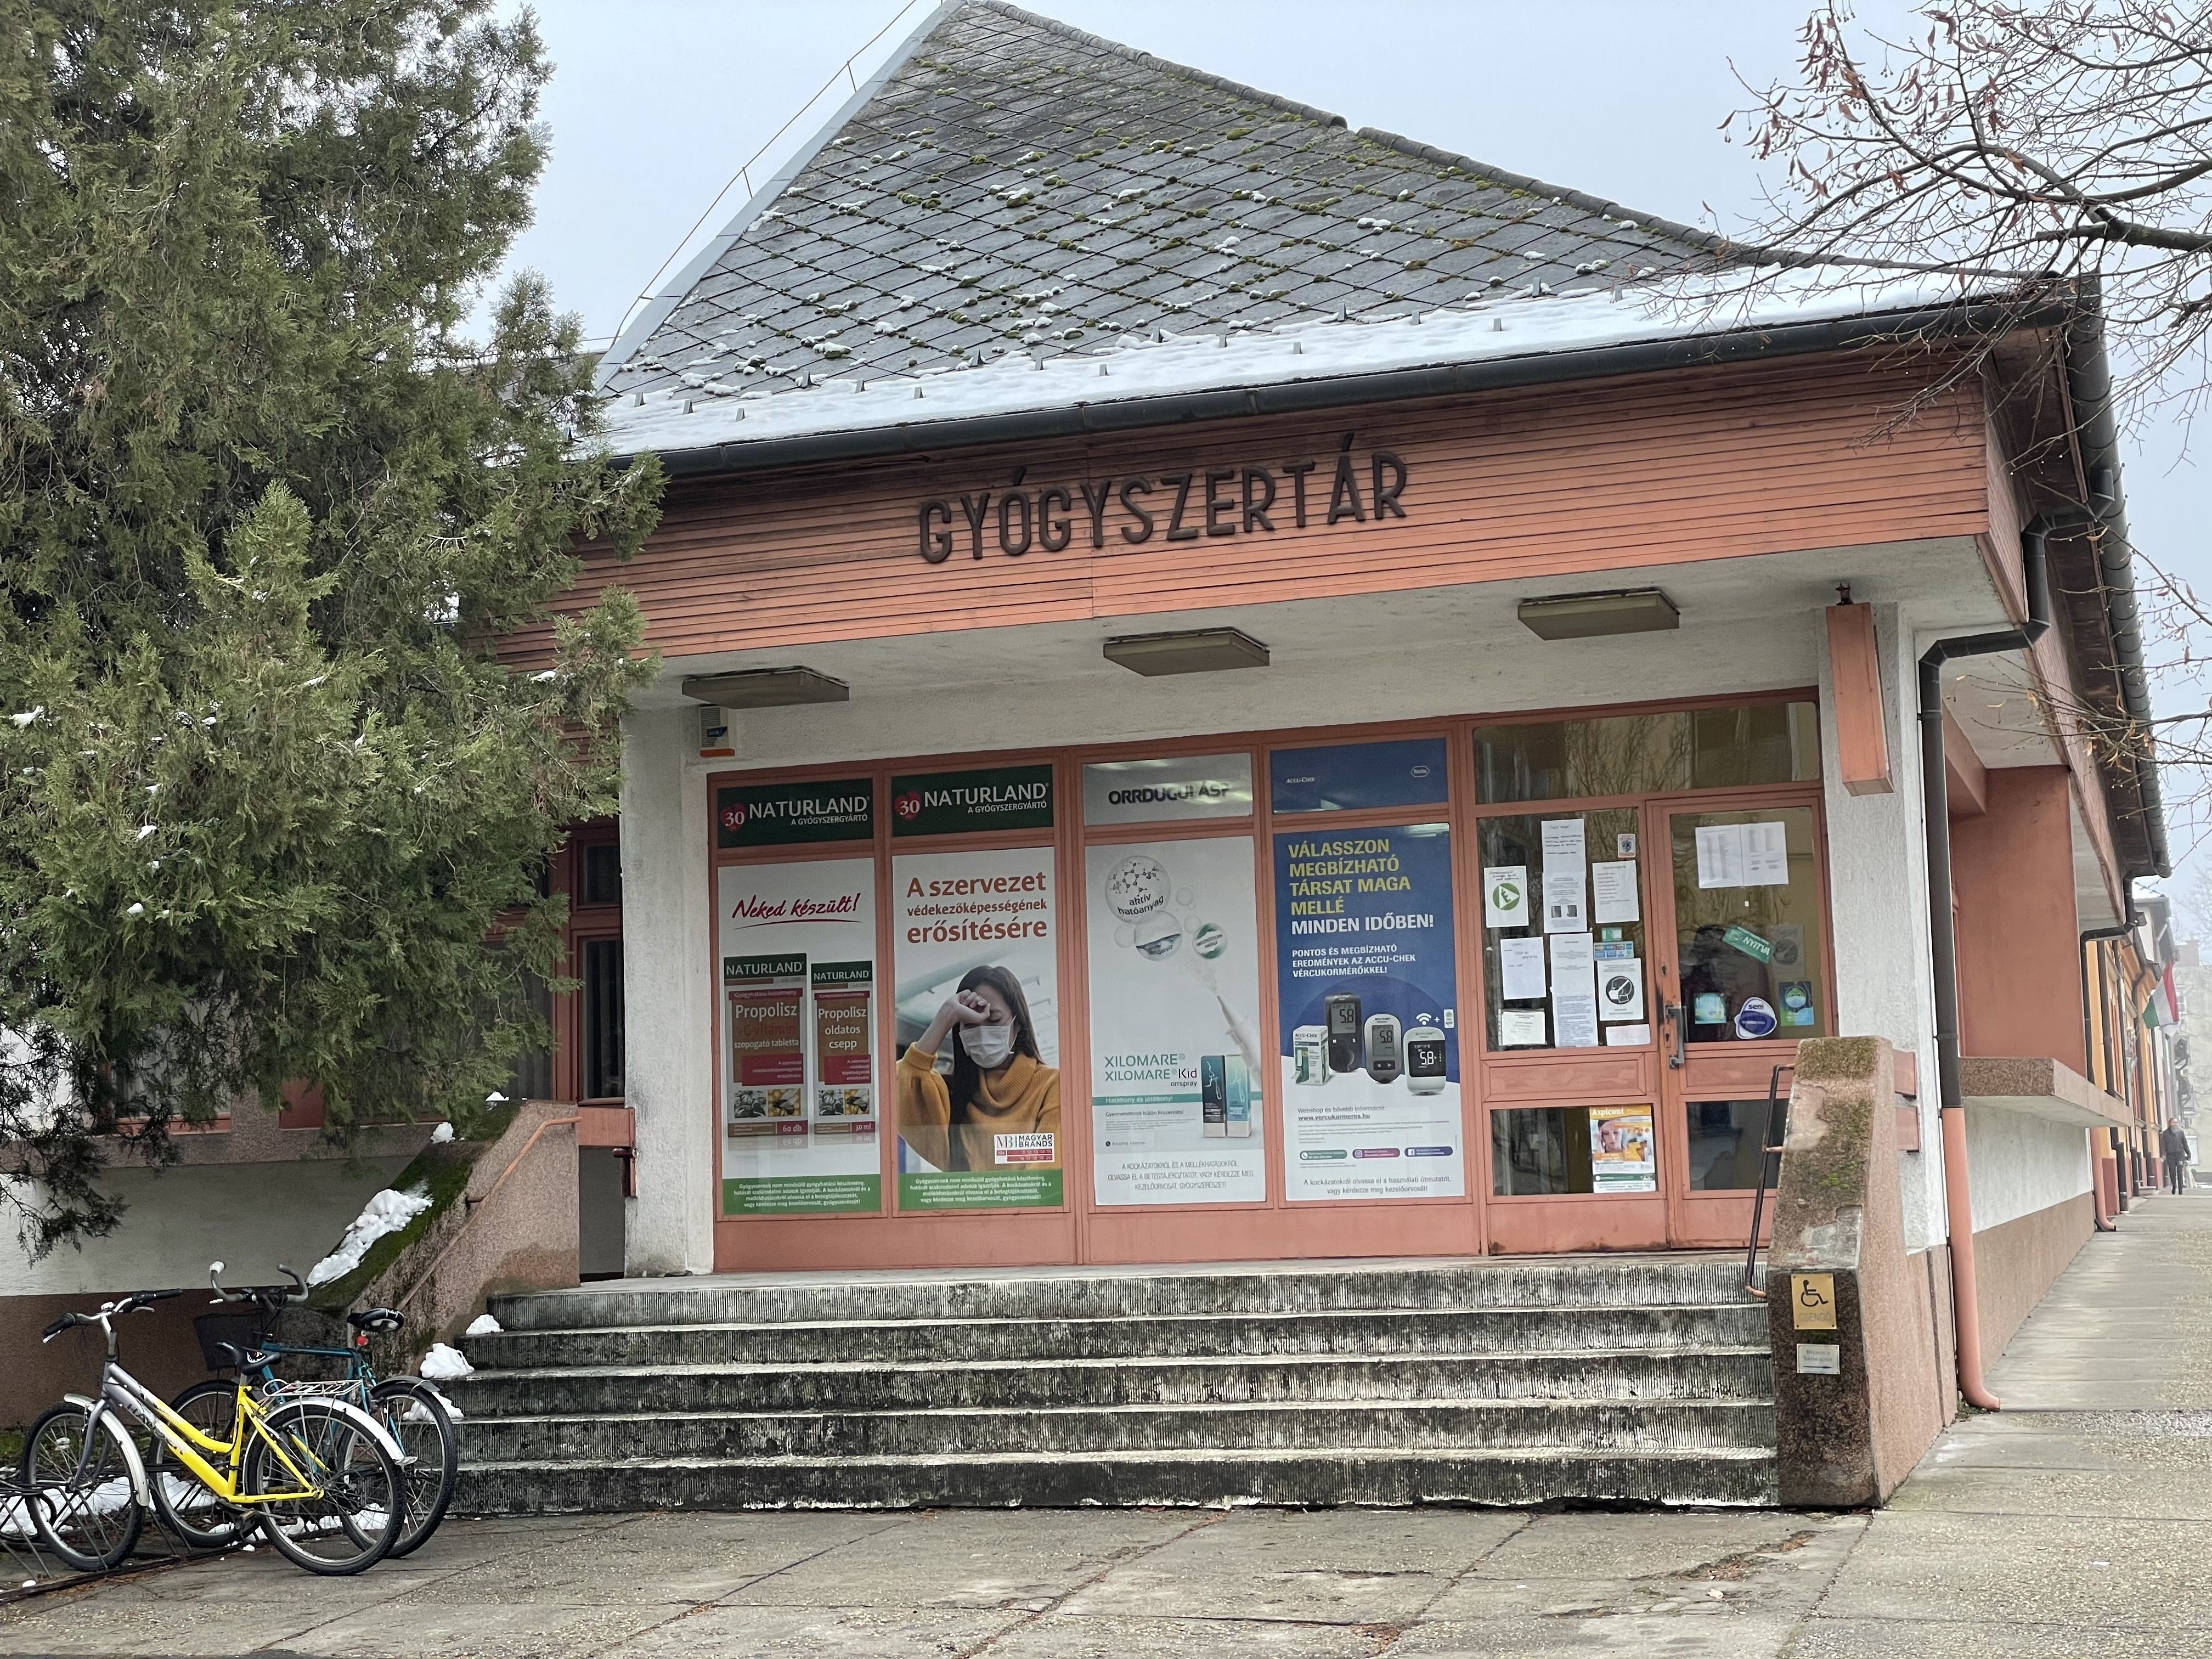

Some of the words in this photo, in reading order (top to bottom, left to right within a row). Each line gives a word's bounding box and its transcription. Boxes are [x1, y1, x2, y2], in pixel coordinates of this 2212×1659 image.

[919, 431, 1407, 564] GYÓGYSZERTÁR
[899, 800, 920, 815] 30
[975, 800, 1047, 813] GYÓGYSZERGYÁRTÓ
[725, 811, 745, 827] 30
[798, 814, 868, 825] GYÓGYSZERGYÁRTÓ
[1288, 839, 1389, 858] VÁLASSZON
[1290, 855, 1399, 877] MEGBÍZHATÓ
[907, 878, 924, 898] A
[929, 872, 1047, 896] szervezet
[1289, 879, 1353, 896] TÁRSAT
[1358, 876, 1410, 891] MAGA
[732, 895, 786, 918] Neked
[791, 893, 861, 916] készült!
[907, 898, 1047, 917] védekezőképességének
[1118, 895, 1164, 916] hatóanyag
[1129, 894, 1151, 906] aktív
[1291, 896, 1344, 915] MELLÉ
[907, 916, 1048, 944] erősítésére
[1292, 917, 1359, 935] MINDEN
[1365, 912, 1434, 930] IDŐBEN!
[1292, 948, 1327, 957] PONTOS
[1329, 946, 1339, 956] ÉS
[1341, 944, 1397, 955] MEGBÍZHATÓ
[1742, 936, 1770, 955] NYITVA
[726, 962, 802, 975] NATURLAND
[1293, 956, 1348, 967] EREDMÉNYEK
[1365, 954, 1416, 964] ACCU-CHEK
[814, 970, 869, 980] NATURLAND
[1293, 966, 1387, 978] VÉRCUKORMÉRŐKKEL!
[736, 1002, 797, 1022] Propolisz
[818, 1006, 866, 1022] Propolisz
[825, 1025, 861, 1035] oldatos
[733, 1040, 770, 1050] szopogató
[771, 1038, 799, 1047] tabletta
[829, 1040, 857, 1051] csepp
[1178, 1068, 1198, 1079] Kid
[1592, 1108, 1624, 1117] Aspicont
